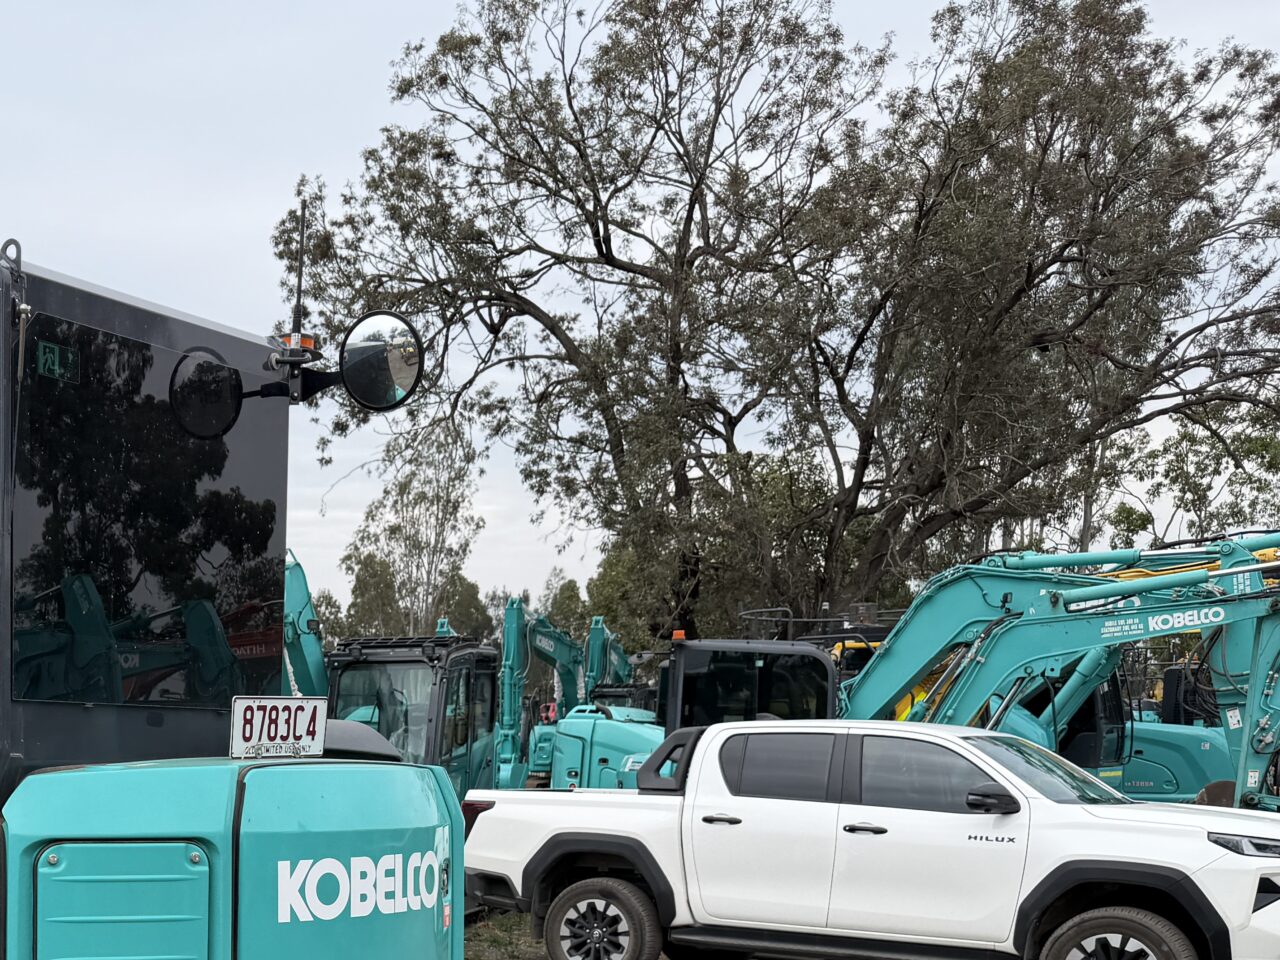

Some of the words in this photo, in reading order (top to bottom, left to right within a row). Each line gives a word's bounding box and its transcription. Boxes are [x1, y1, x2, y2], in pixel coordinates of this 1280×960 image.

[1147, 606, 1226, 632] KOBELCO
[242, 704, 318, 743] 8783C4
[967, 834, 1017, 844] HILUX
[277, 850, 439, 923] KOBELCO
